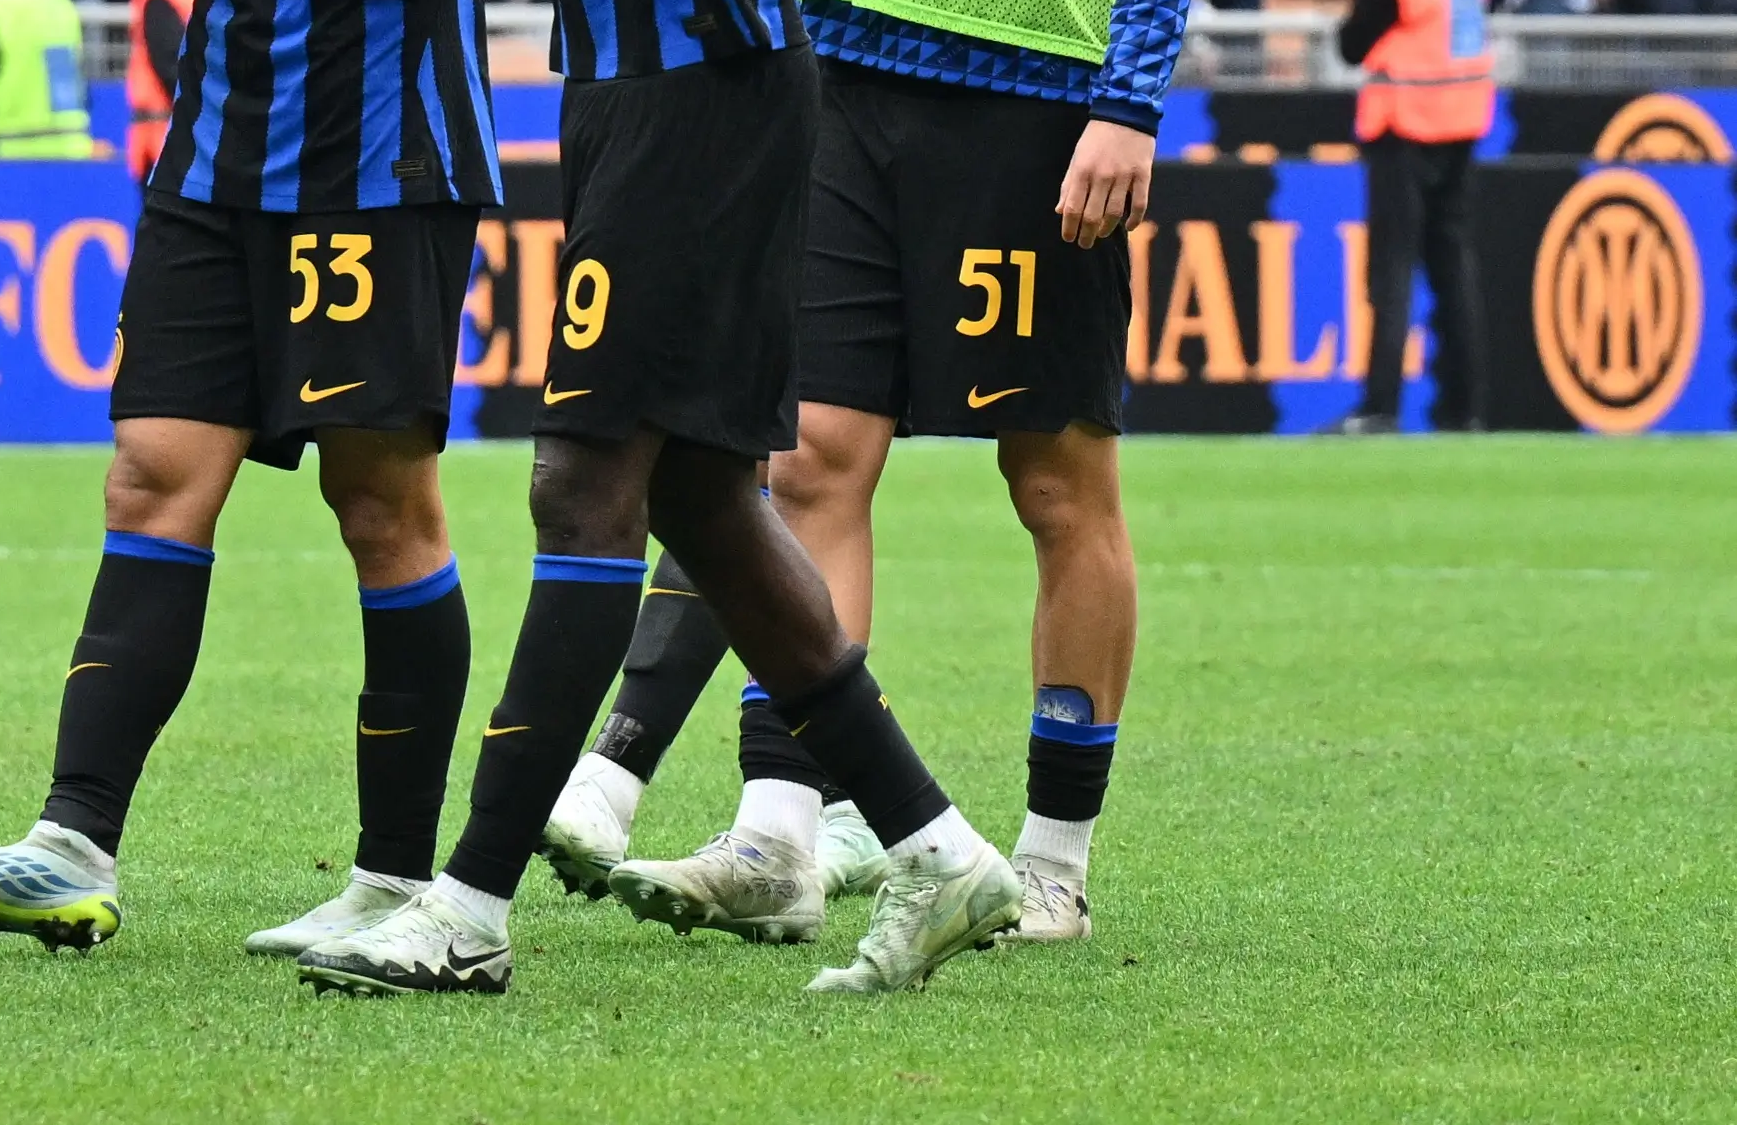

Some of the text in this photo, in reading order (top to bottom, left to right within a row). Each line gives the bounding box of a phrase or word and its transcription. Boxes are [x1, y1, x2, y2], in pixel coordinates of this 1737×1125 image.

[290, 233, 373, 323] 53
[563, 258, 611, 350] 9
[955, 248, 1036, 337] 51
